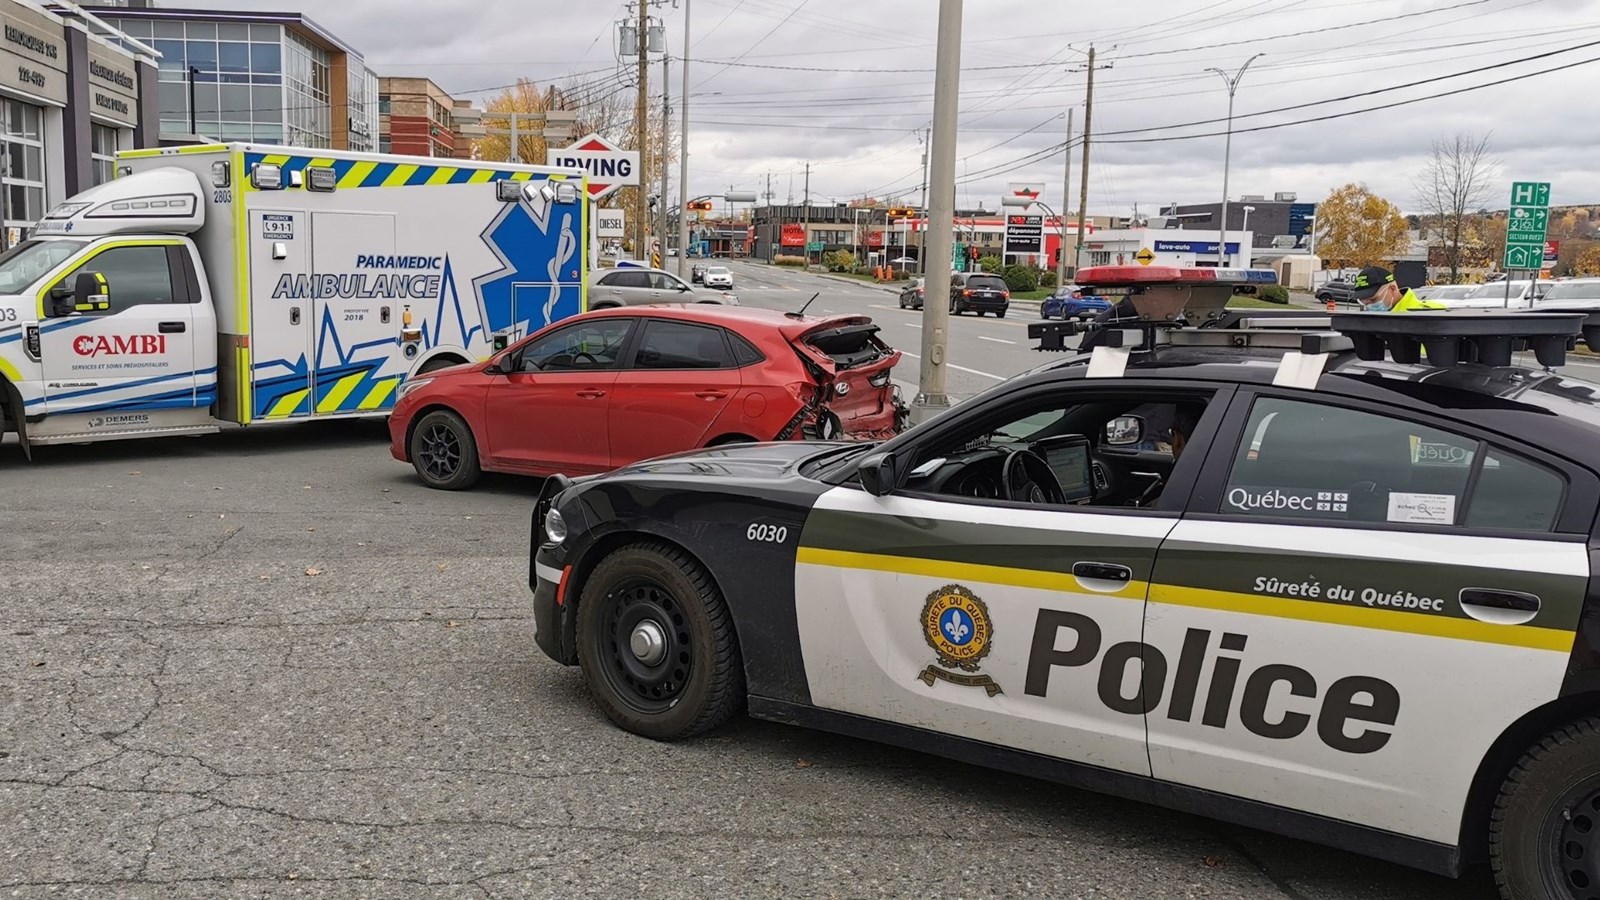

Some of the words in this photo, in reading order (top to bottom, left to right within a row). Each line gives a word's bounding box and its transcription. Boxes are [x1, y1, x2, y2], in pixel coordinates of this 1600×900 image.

[213, 190, 232, 203] 2803
[1515, 185, 1533, 203] H
[599, 218, 623, 229] DIESEL
[356, 255, 441, 269] PARAMEDIC
[271, 273, 441, 299] AMBULANCE
[73, 335, 165, 358] CAMBI
[1228, 488, 1313, 510] Québec
[746, 523, 788, 544] 6030
[949, 596, 963, 606] DU
[1253, 576, 1320, 598] Sûreté
[1326, 585, 1355, 602] du
[1360, 588, 1445, 612] Québec
[940, 640, 975, 656] POLICE
[1024, 608, 1401, 754] Police
